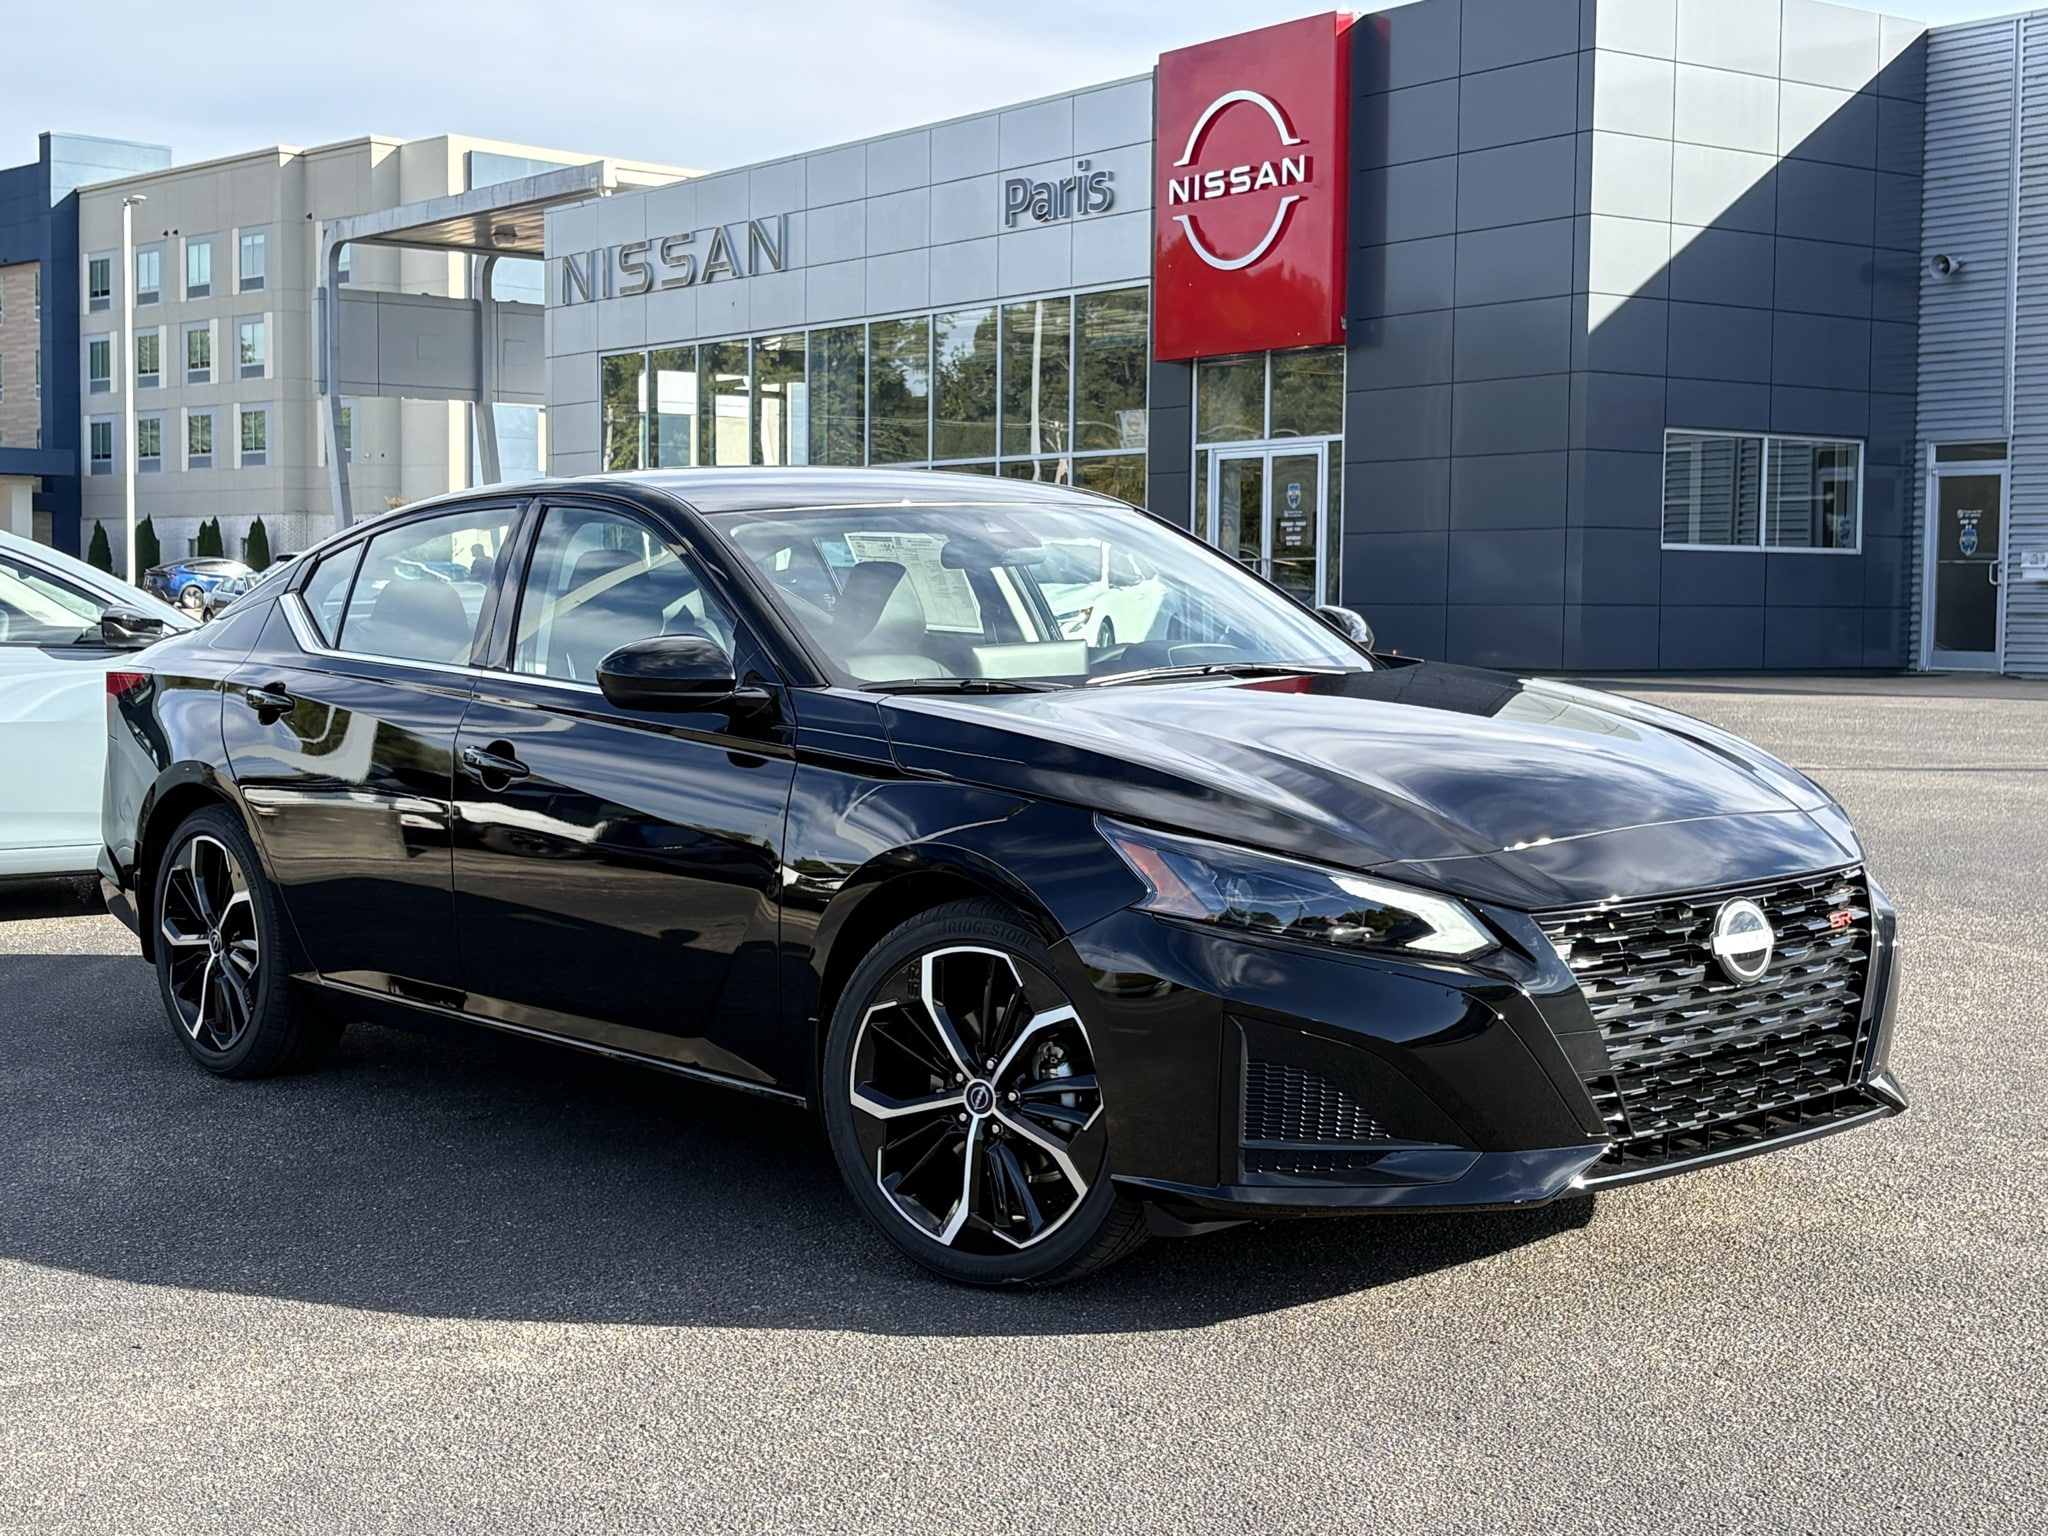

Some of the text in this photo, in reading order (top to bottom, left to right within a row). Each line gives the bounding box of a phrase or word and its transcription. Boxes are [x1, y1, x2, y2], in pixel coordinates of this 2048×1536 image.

[1003, 158, 1115, 228] Paris
[1168, 154, 1306, 206] NISSAN
[561, 212, 789, 307] NISSAN
[937, 920, 1034, 950] BRIDGESTONE
[1829, 911, 1853, 928] SR
